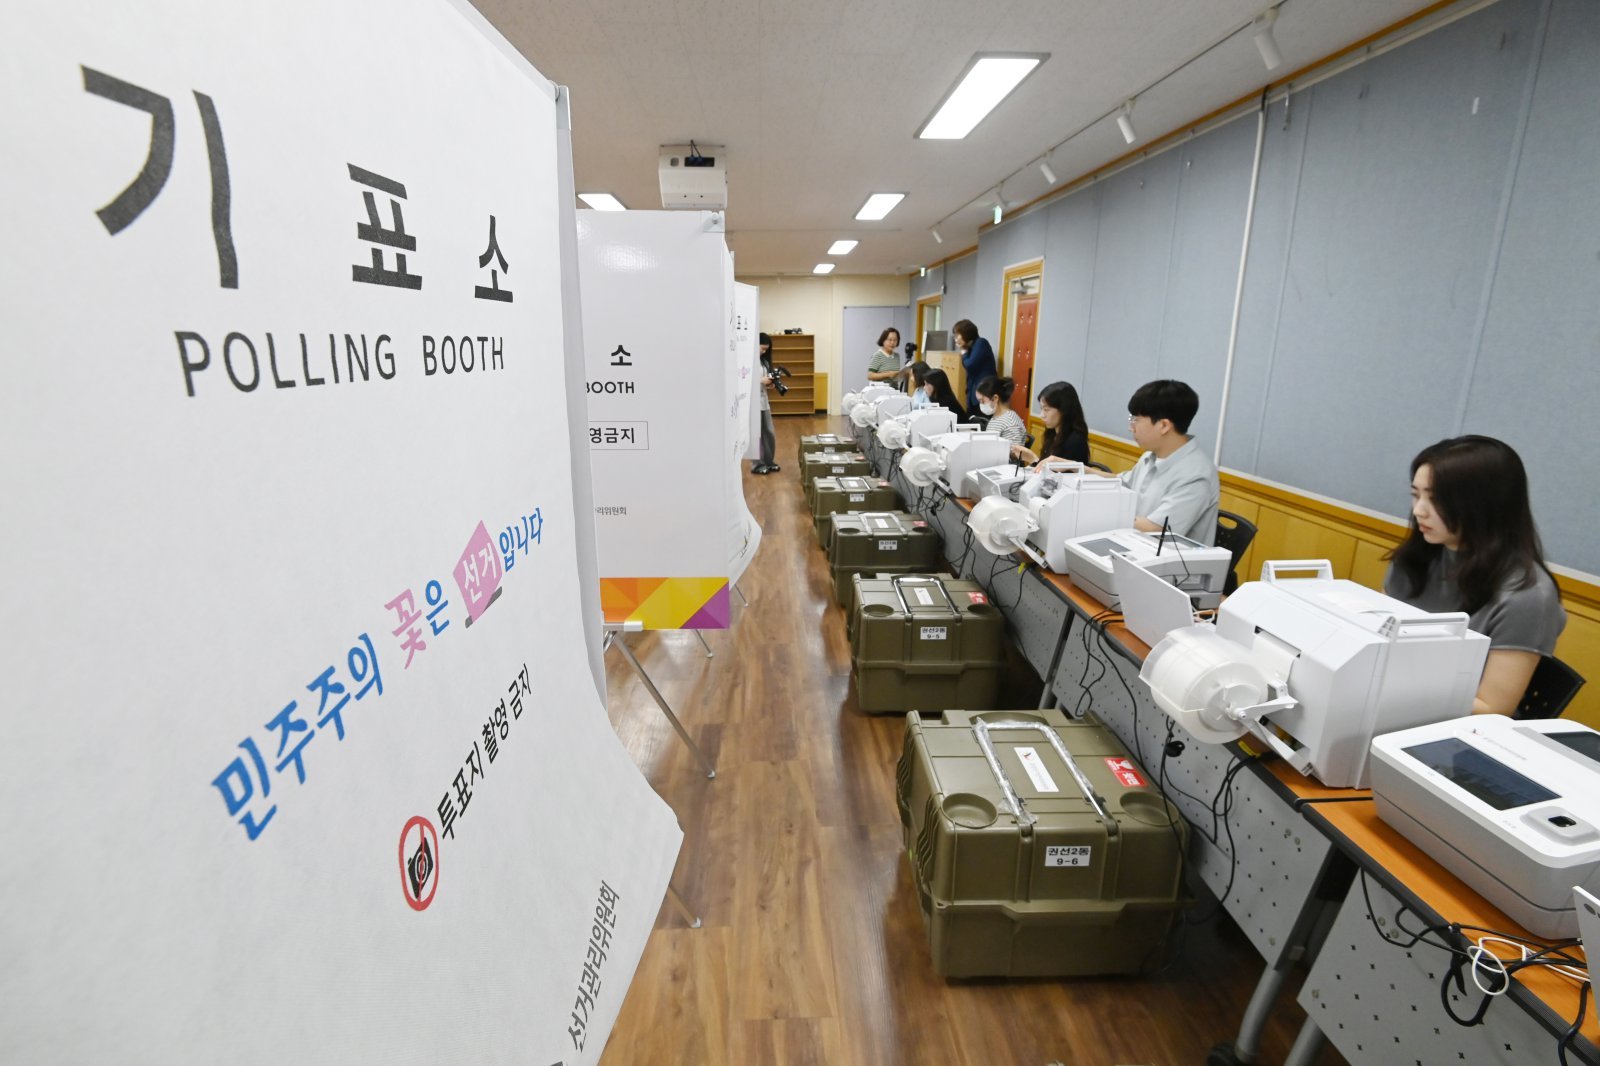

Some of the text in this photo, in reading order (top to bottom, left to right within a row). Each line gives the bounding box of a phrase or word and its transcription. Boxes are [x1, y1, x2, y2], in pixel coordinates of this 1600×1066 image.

[174, 331, 505, 397] POLLING BOOTH
[595, 506, 627, 516] 리위원회
[210, 508, 544, 841] 민주주의 꽃은 선거입니다
[437, 663, 531, 840] 투표지 촬영 금지
[1056, 857, 1079, 866] 9-6
[567, 879, 620, 1053] 선거관리위원회
